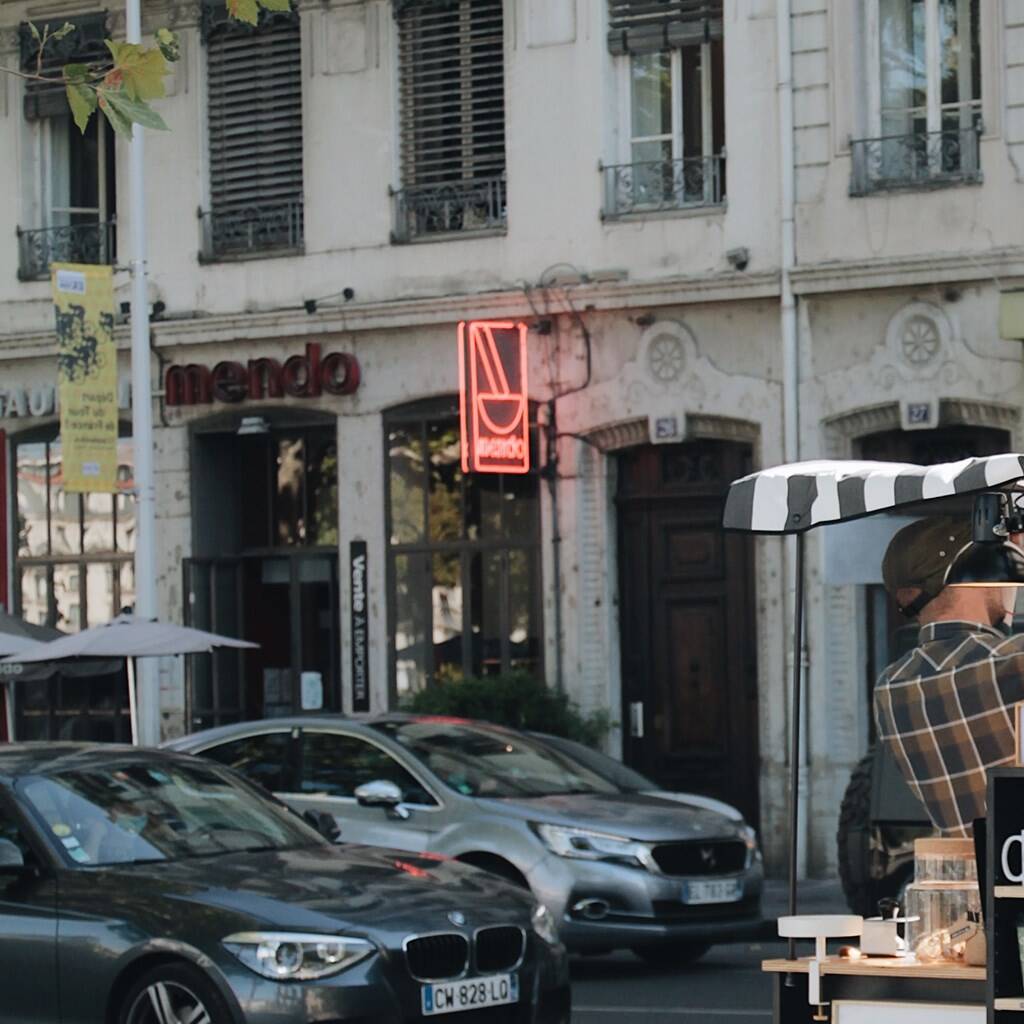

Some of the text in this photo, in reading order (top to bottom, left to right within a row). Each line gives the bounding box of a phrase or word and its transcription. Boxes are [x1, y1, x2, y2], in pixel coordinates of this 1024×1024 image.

[165, 343, 360, 406] mendo
[353, 555, 364, 612] Vente
[434, 988, 454, 1010] CW
[459, 983, 487, 1005] 828
